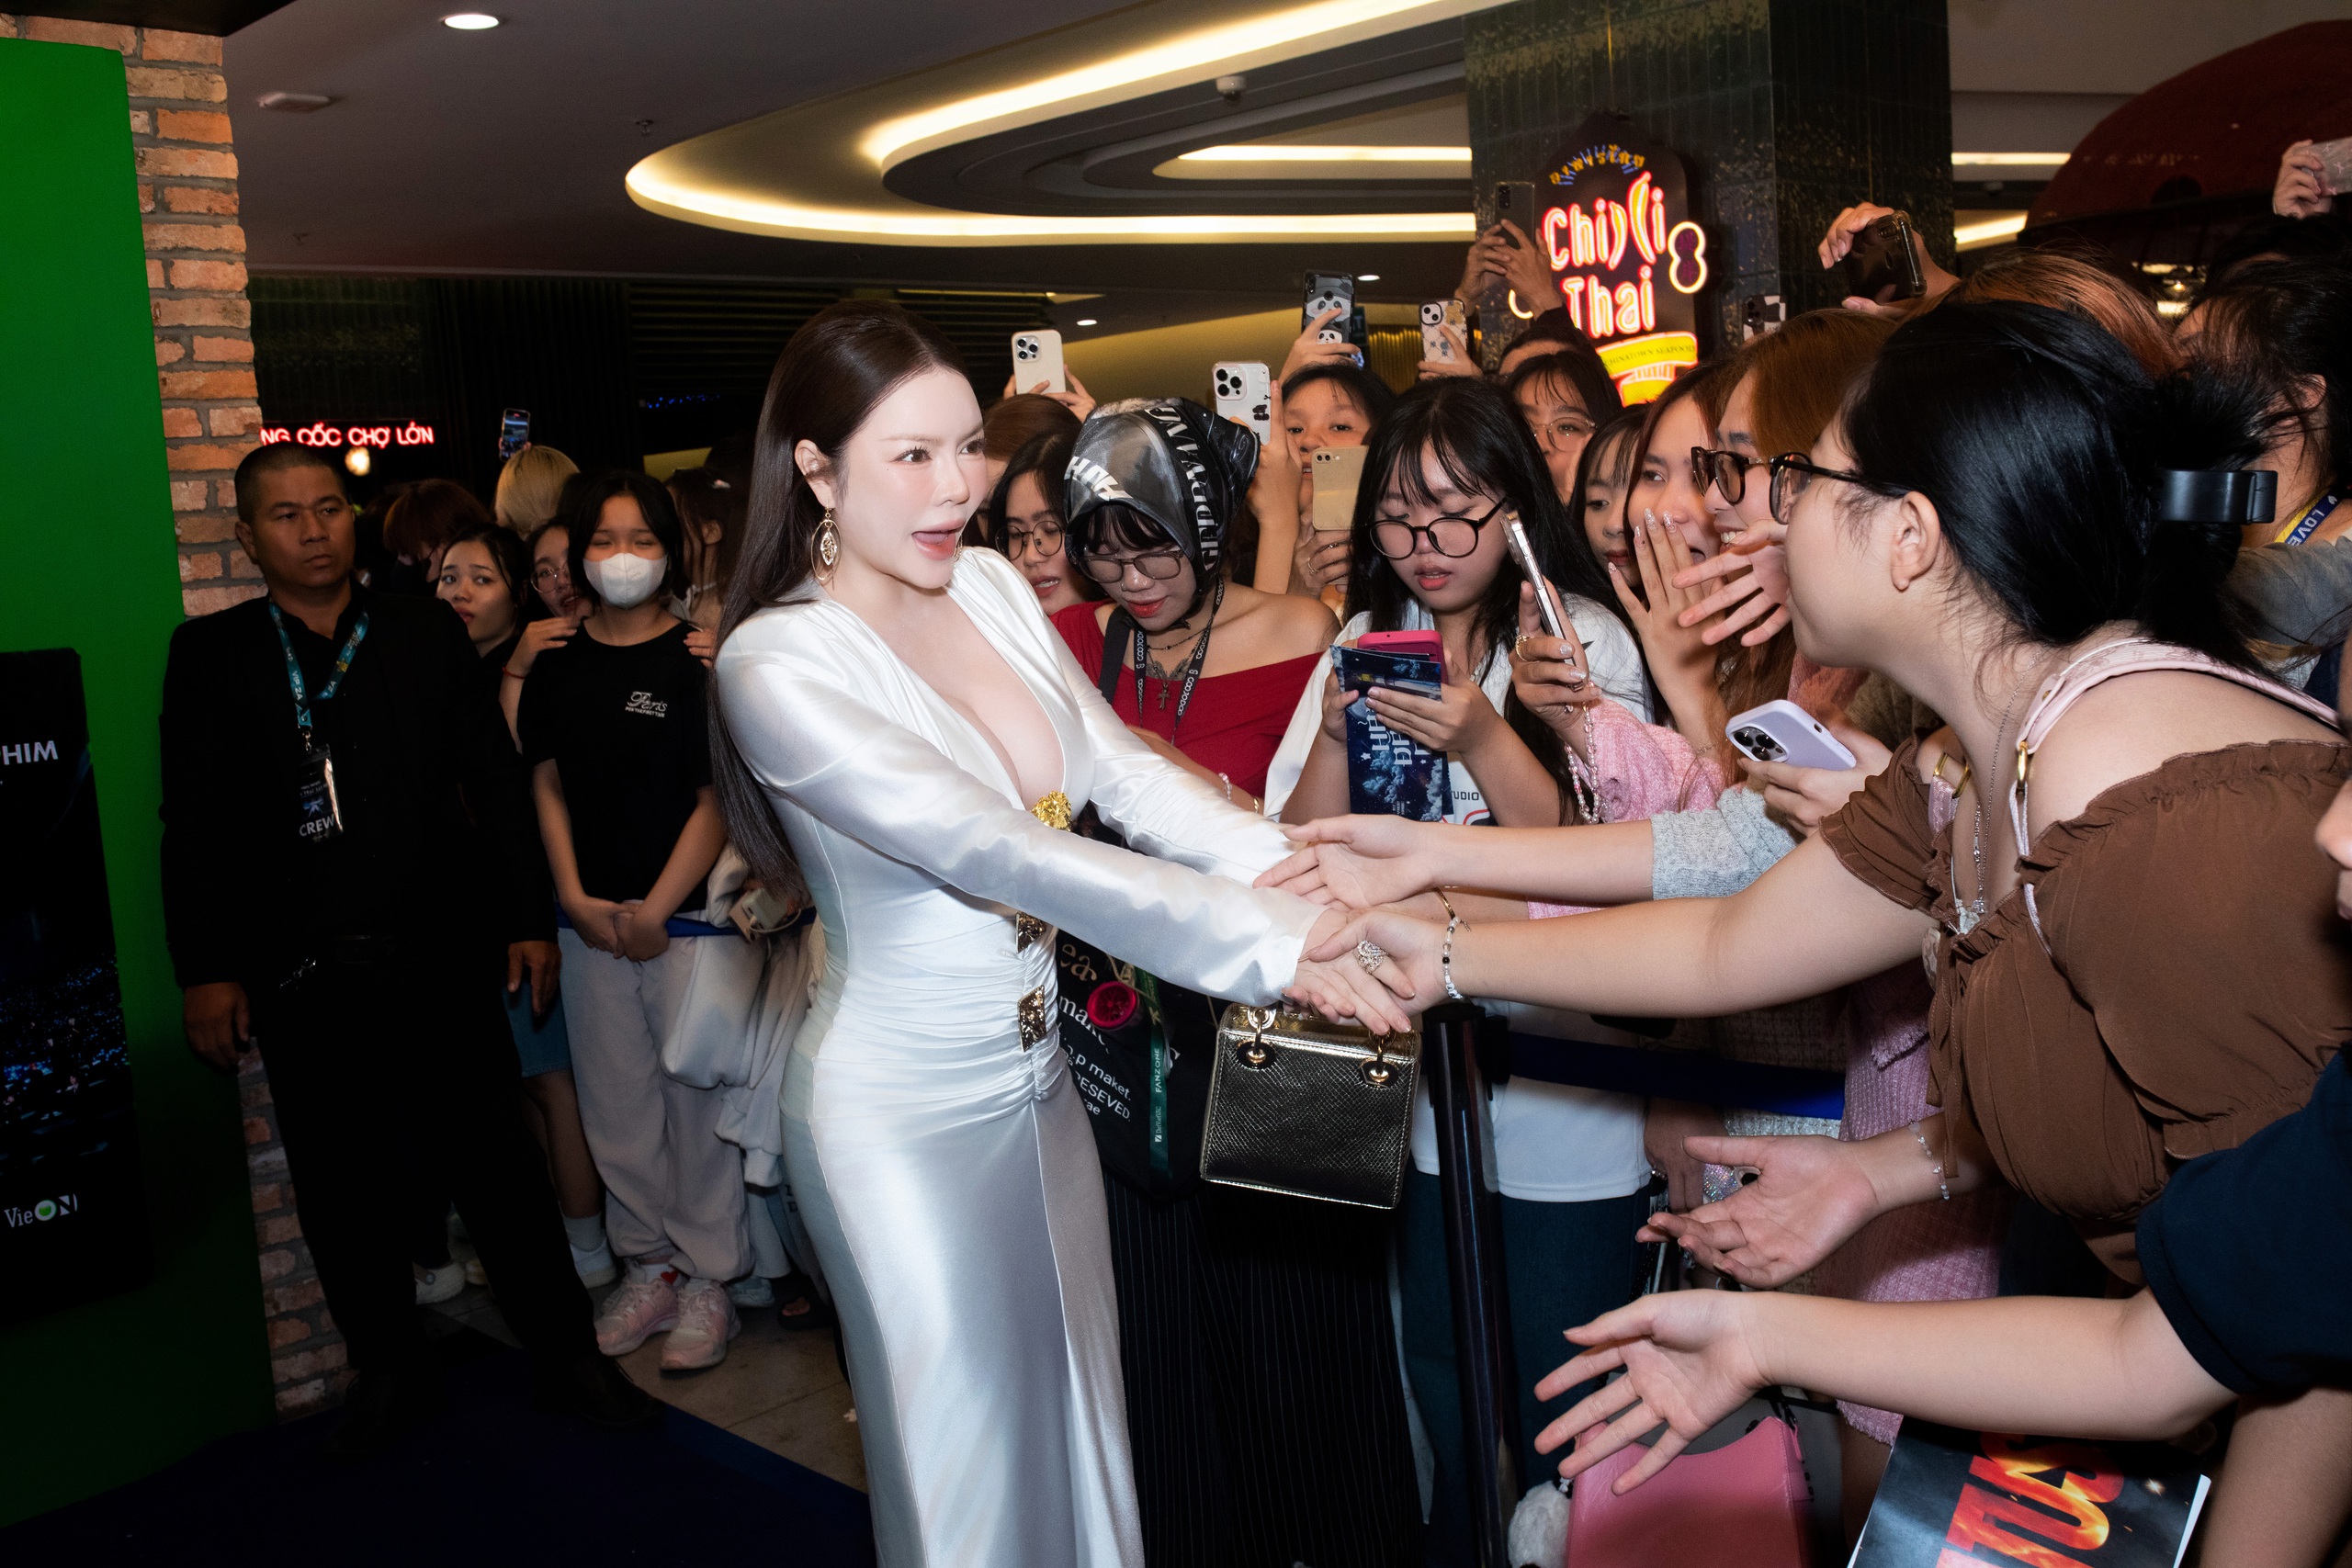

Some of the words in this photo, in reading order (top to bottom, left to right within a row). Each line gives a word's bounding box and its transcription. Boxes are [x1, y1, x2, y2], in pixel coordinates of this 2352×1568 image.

[1560, 264, 1656, 339] Thai
[297, 420, 343, 447] CỐC
[347, 426, 390, 450] CHỢ
[396, 420, 435, 446] LỚN
[2287, 509, 2325, 547] LOVE
[292, 670, 301, 685] VIP
[294, 686, 303, 701] 2A
[0, 739, 59, 765] HIM
[299, 814, 334, 837] CREW
[1090, 1063, 1132, 1101] maket.
[1155, 1048, 1165, 1093] FANZONE
